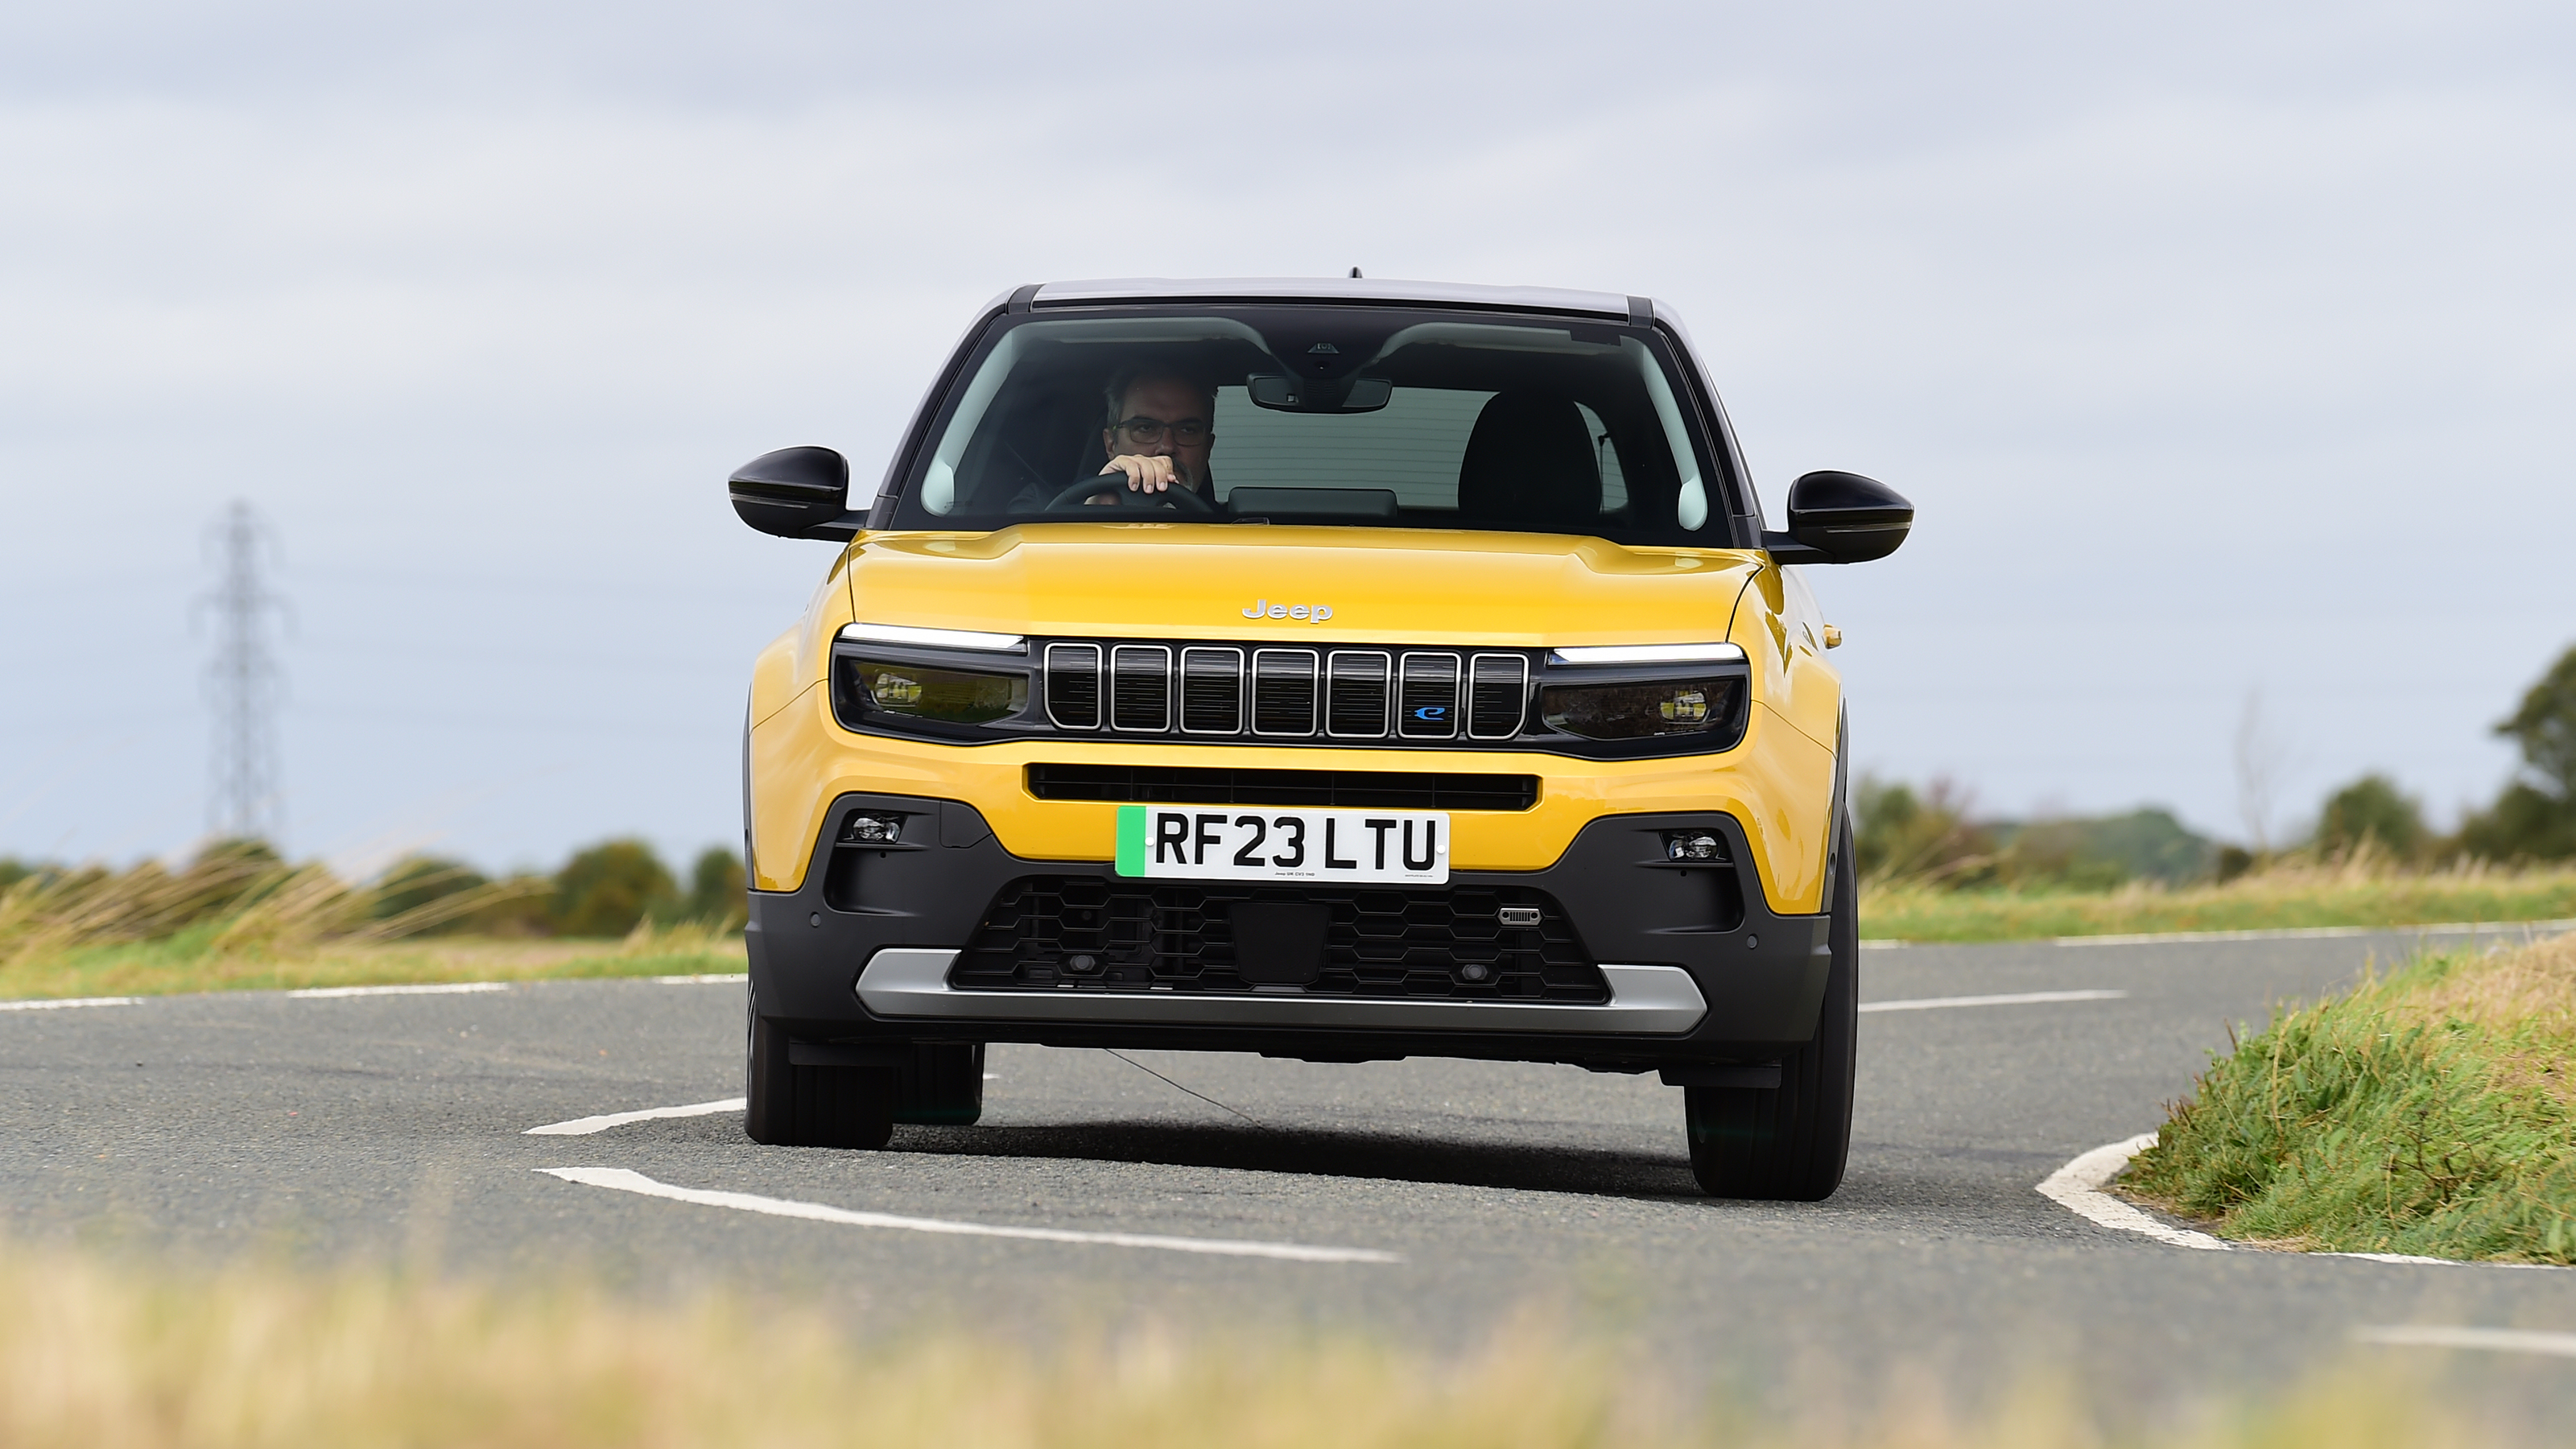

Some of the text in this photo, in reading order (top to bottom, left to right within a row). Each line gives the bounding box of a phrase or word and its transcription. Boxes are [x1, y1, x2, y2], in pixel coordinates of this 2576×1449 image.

[1242, 599, 1333, 624] Jeep
[1156, 812, 1436, 871] RF23 LTU
